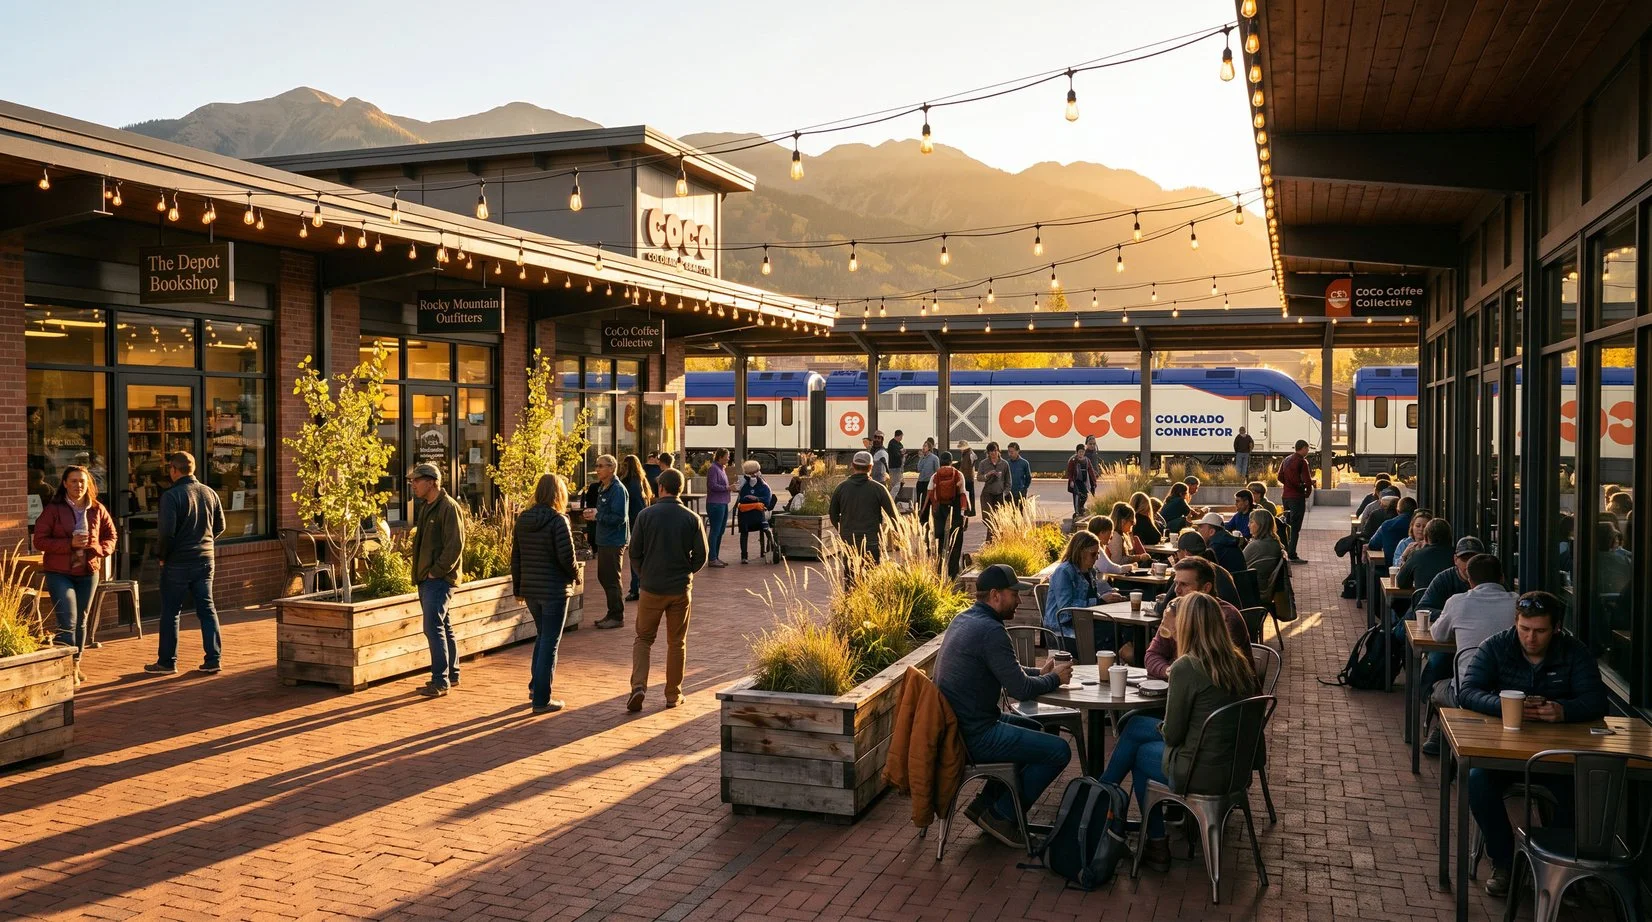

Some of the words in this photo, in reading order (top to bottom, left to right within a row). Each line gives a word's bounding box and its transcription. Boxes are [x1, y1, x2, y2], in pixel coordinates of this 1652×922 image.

[646, 207, 714, 260] COCO
[147, 255, 174, 272] The
[177, 254, 220, 273] Depot
[150, 273, 218, 295] Bookshop
[1386, 286, 1424, 296] Coffee
[420, 299, 450, 312] Rocky
[453, 298, 499, 310] Mountain
[1355, 297, 1413, 307] Collective
[436, 312, 483, 324] Outfitters
[604, 326, 629, 336] CoCo
[630, 325, 660, 336] Coffee
[610, 337, 653, 348] Collective
[999, 400, 1142, 439] COCO
[1155, 415, 1225, 424] COLORADO
[1155, 427, 1233, 437] CONNECTOR
